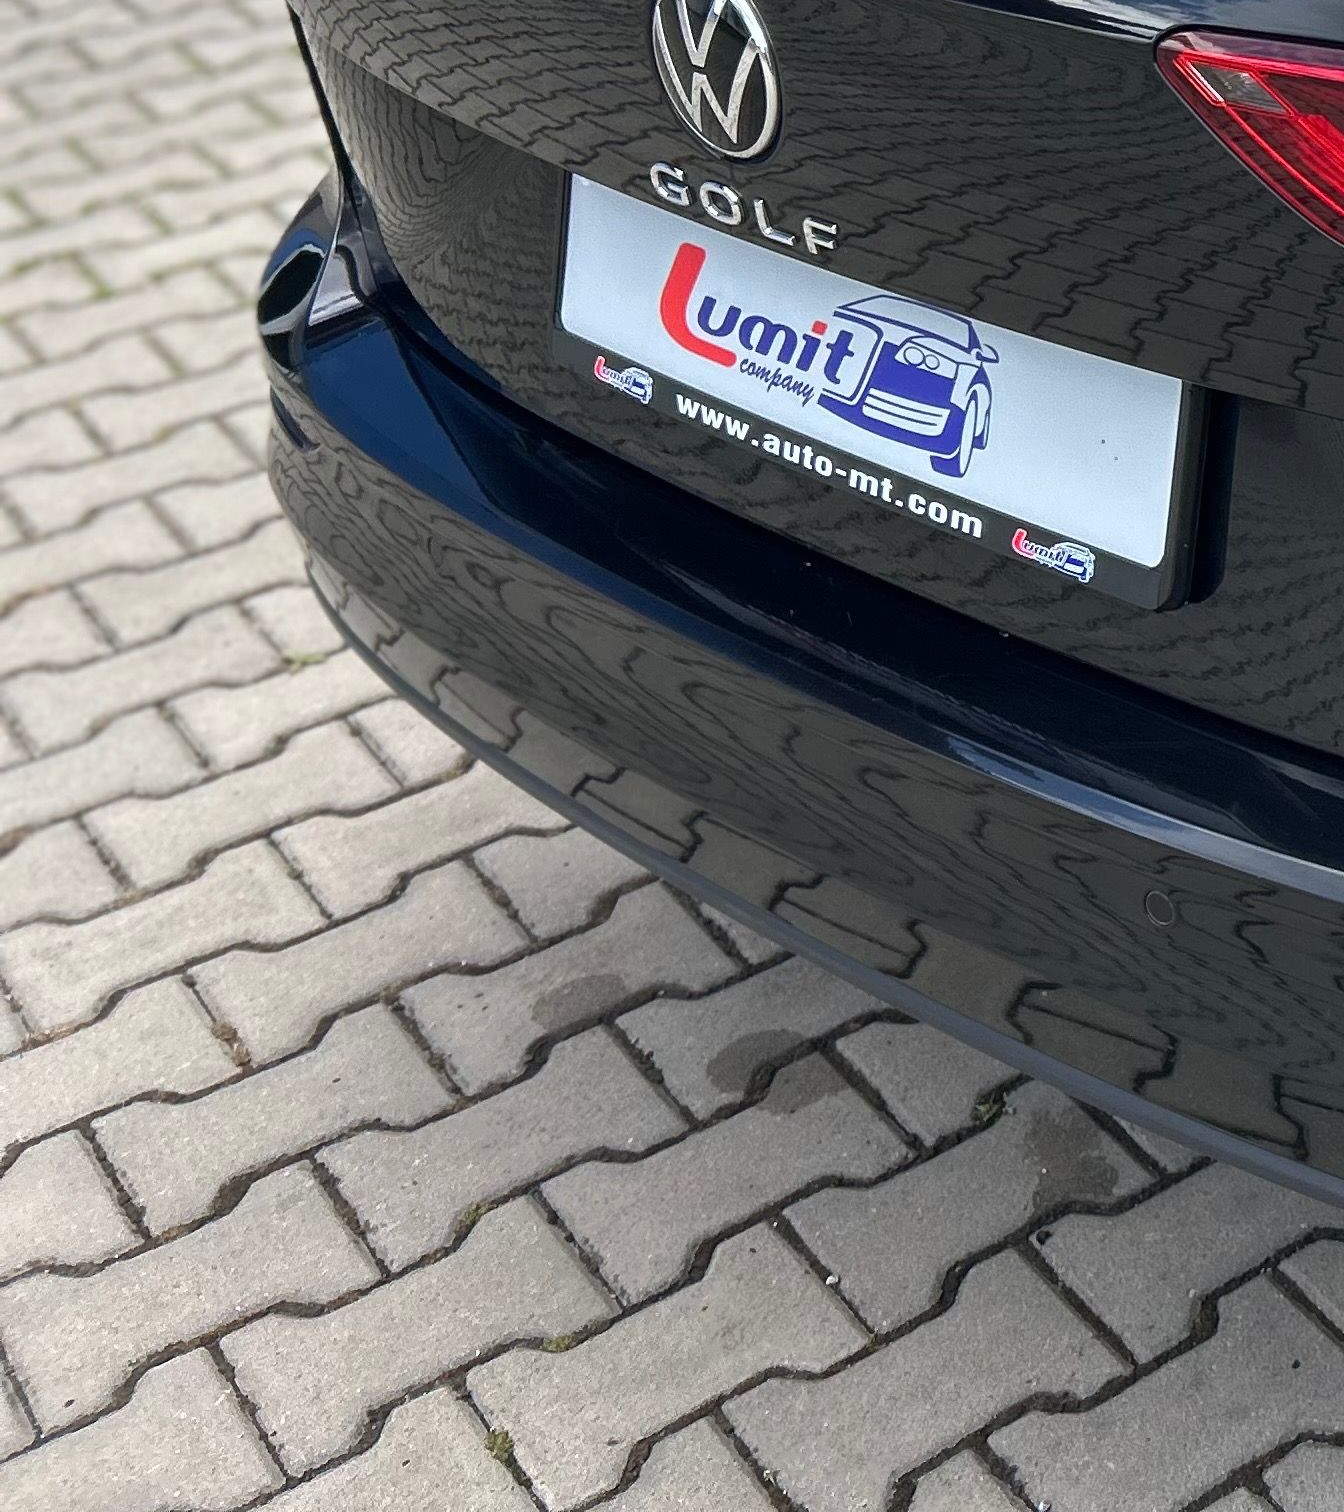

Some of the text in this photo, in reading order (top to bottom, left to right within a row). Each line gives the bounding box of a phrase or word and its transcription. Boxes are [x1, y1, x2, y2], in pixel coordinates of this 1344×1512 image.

[650, 161, 839, 255] GOLF
[660, 242, 854, 385] Lumit
[739, 358, 815, 407] company
[675, 393, 983, 538] www.auto-mt.com
